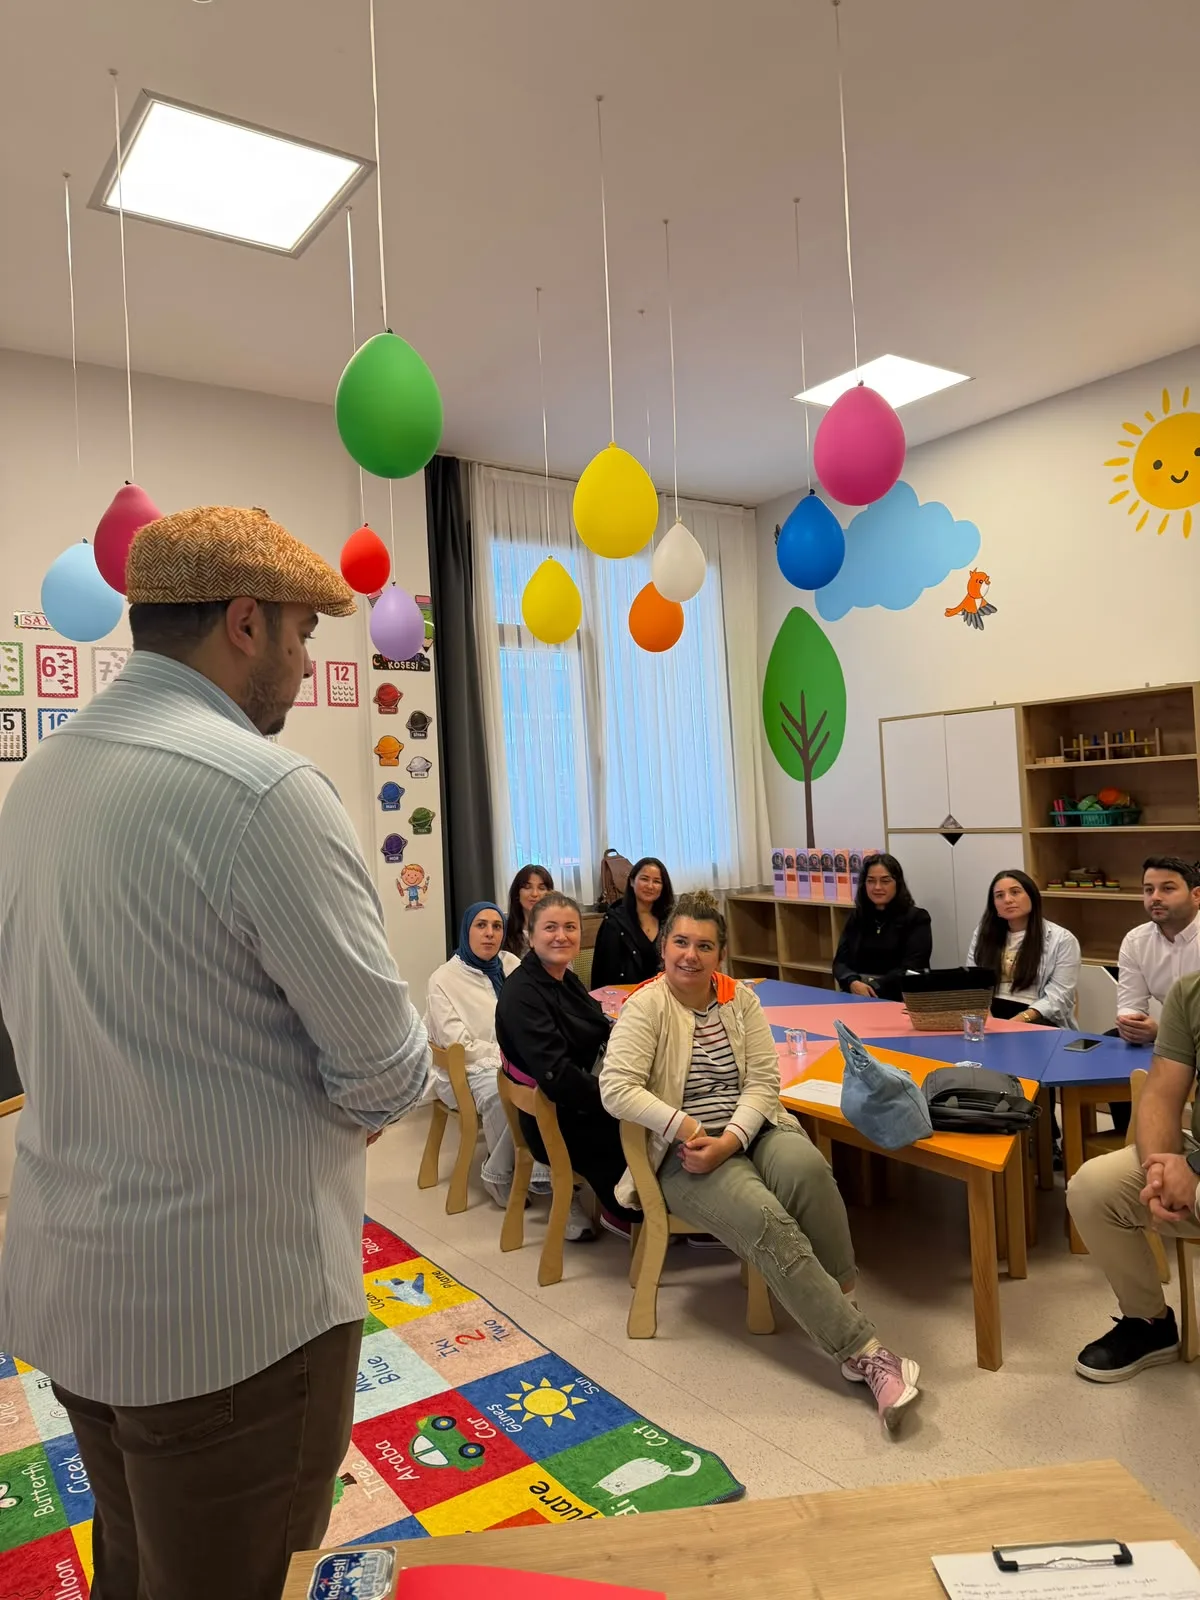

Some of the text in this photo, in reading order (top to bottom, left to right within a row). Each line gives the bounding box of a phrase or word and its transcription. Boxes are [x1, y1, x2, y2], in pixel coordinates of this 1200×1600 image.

[42, 656, 57, 678] 6
[98, 661, 113, 681] 7
[334, 666, 350, 681] 12
[0, 713, 15, 731] 5
[431, 1270, 456, 1289] Plane
[455, 1329, 486, 1346] 2
[367, 1355, 401, 1385] Blue
[575, 1376, 600, 1396] Sun
[466, 1417, 497, 1439] Car
[632, 1425, 669, 1447] Cat
[375, 1439, 420, 1481] Araba
[21, 1460, 55, 1518] Butterfly
[351, 1459, 386, 1499] Tree
